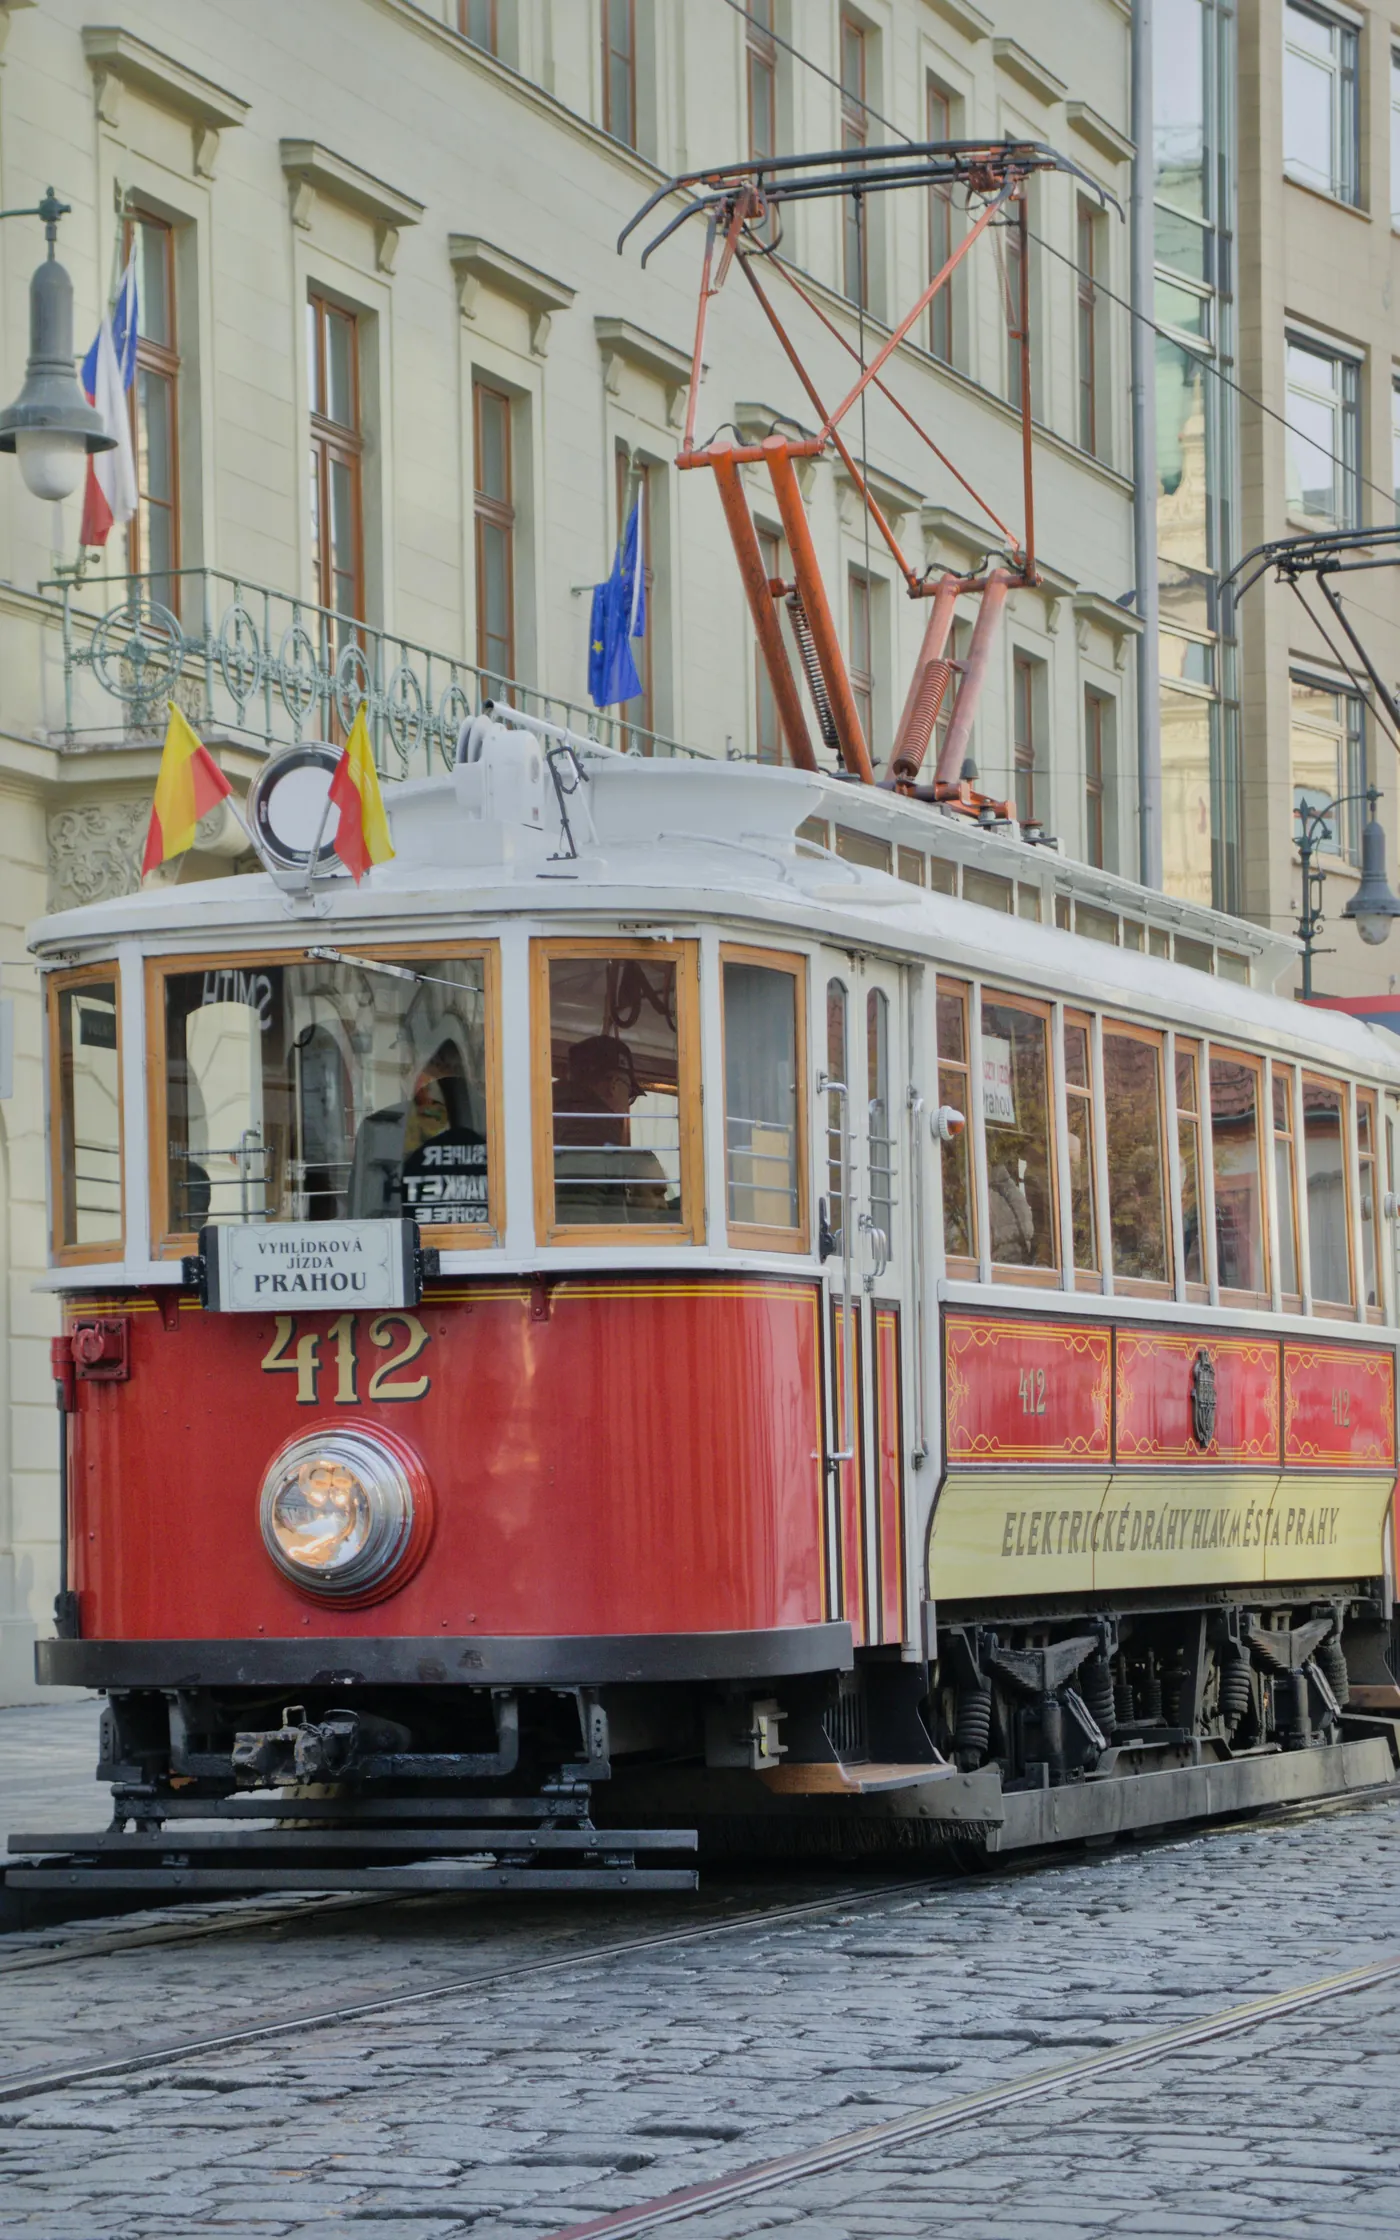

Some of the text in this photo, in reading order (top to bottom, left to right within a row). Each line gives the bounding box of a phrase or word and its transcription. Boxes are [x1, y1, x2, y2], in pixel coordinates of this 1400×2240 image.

[258, 1237, 363, 1254] VYHLÍDKOVÁ
[286, 1253, 334, 1270] JÍZDA
[254, 1271, 367, 1293] PRAHOU
[261, 1313, 432, 1406] 412
[1018, 1368, 1046, 1416] 412
[1332, 1388, 1350, 1428] 412
[1001, 1502, 1131, 1557] ELEKTRICKÉ
[1129, 1502, 1193, 1551] DRÁHY
[1285, 1507, 1340, 1546] PRAHY.
